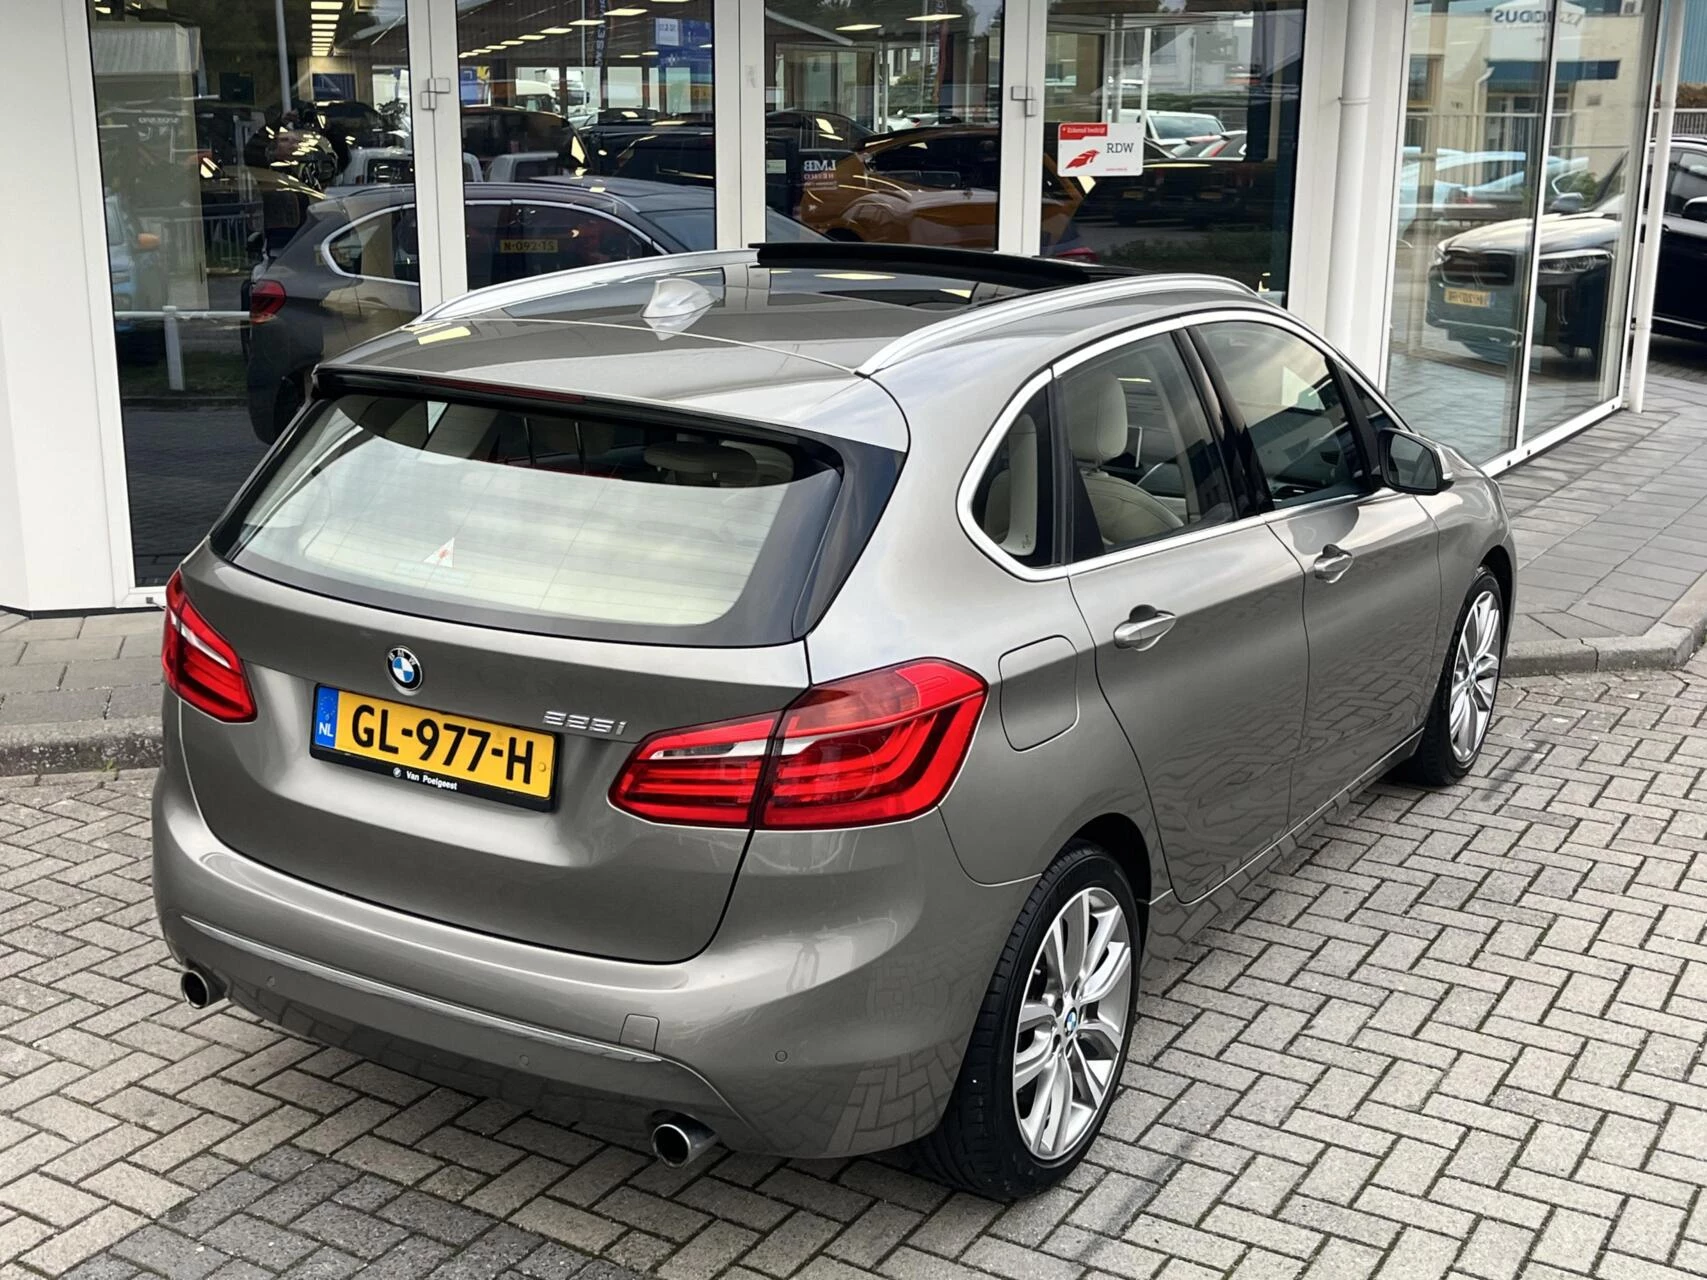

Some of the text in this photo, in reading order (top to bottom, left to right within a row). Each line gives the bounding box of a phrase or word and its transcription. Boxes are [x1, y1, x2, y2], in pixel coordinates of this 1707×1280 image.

[1106, 142, 1134, 154] RDW
[318, 721, 334, 739] NL
[543, 710, 627, 736] 225i
[351, 704, 535, 785] GL-977-H
[406, 770, 458, 791] Van Poelgeest
